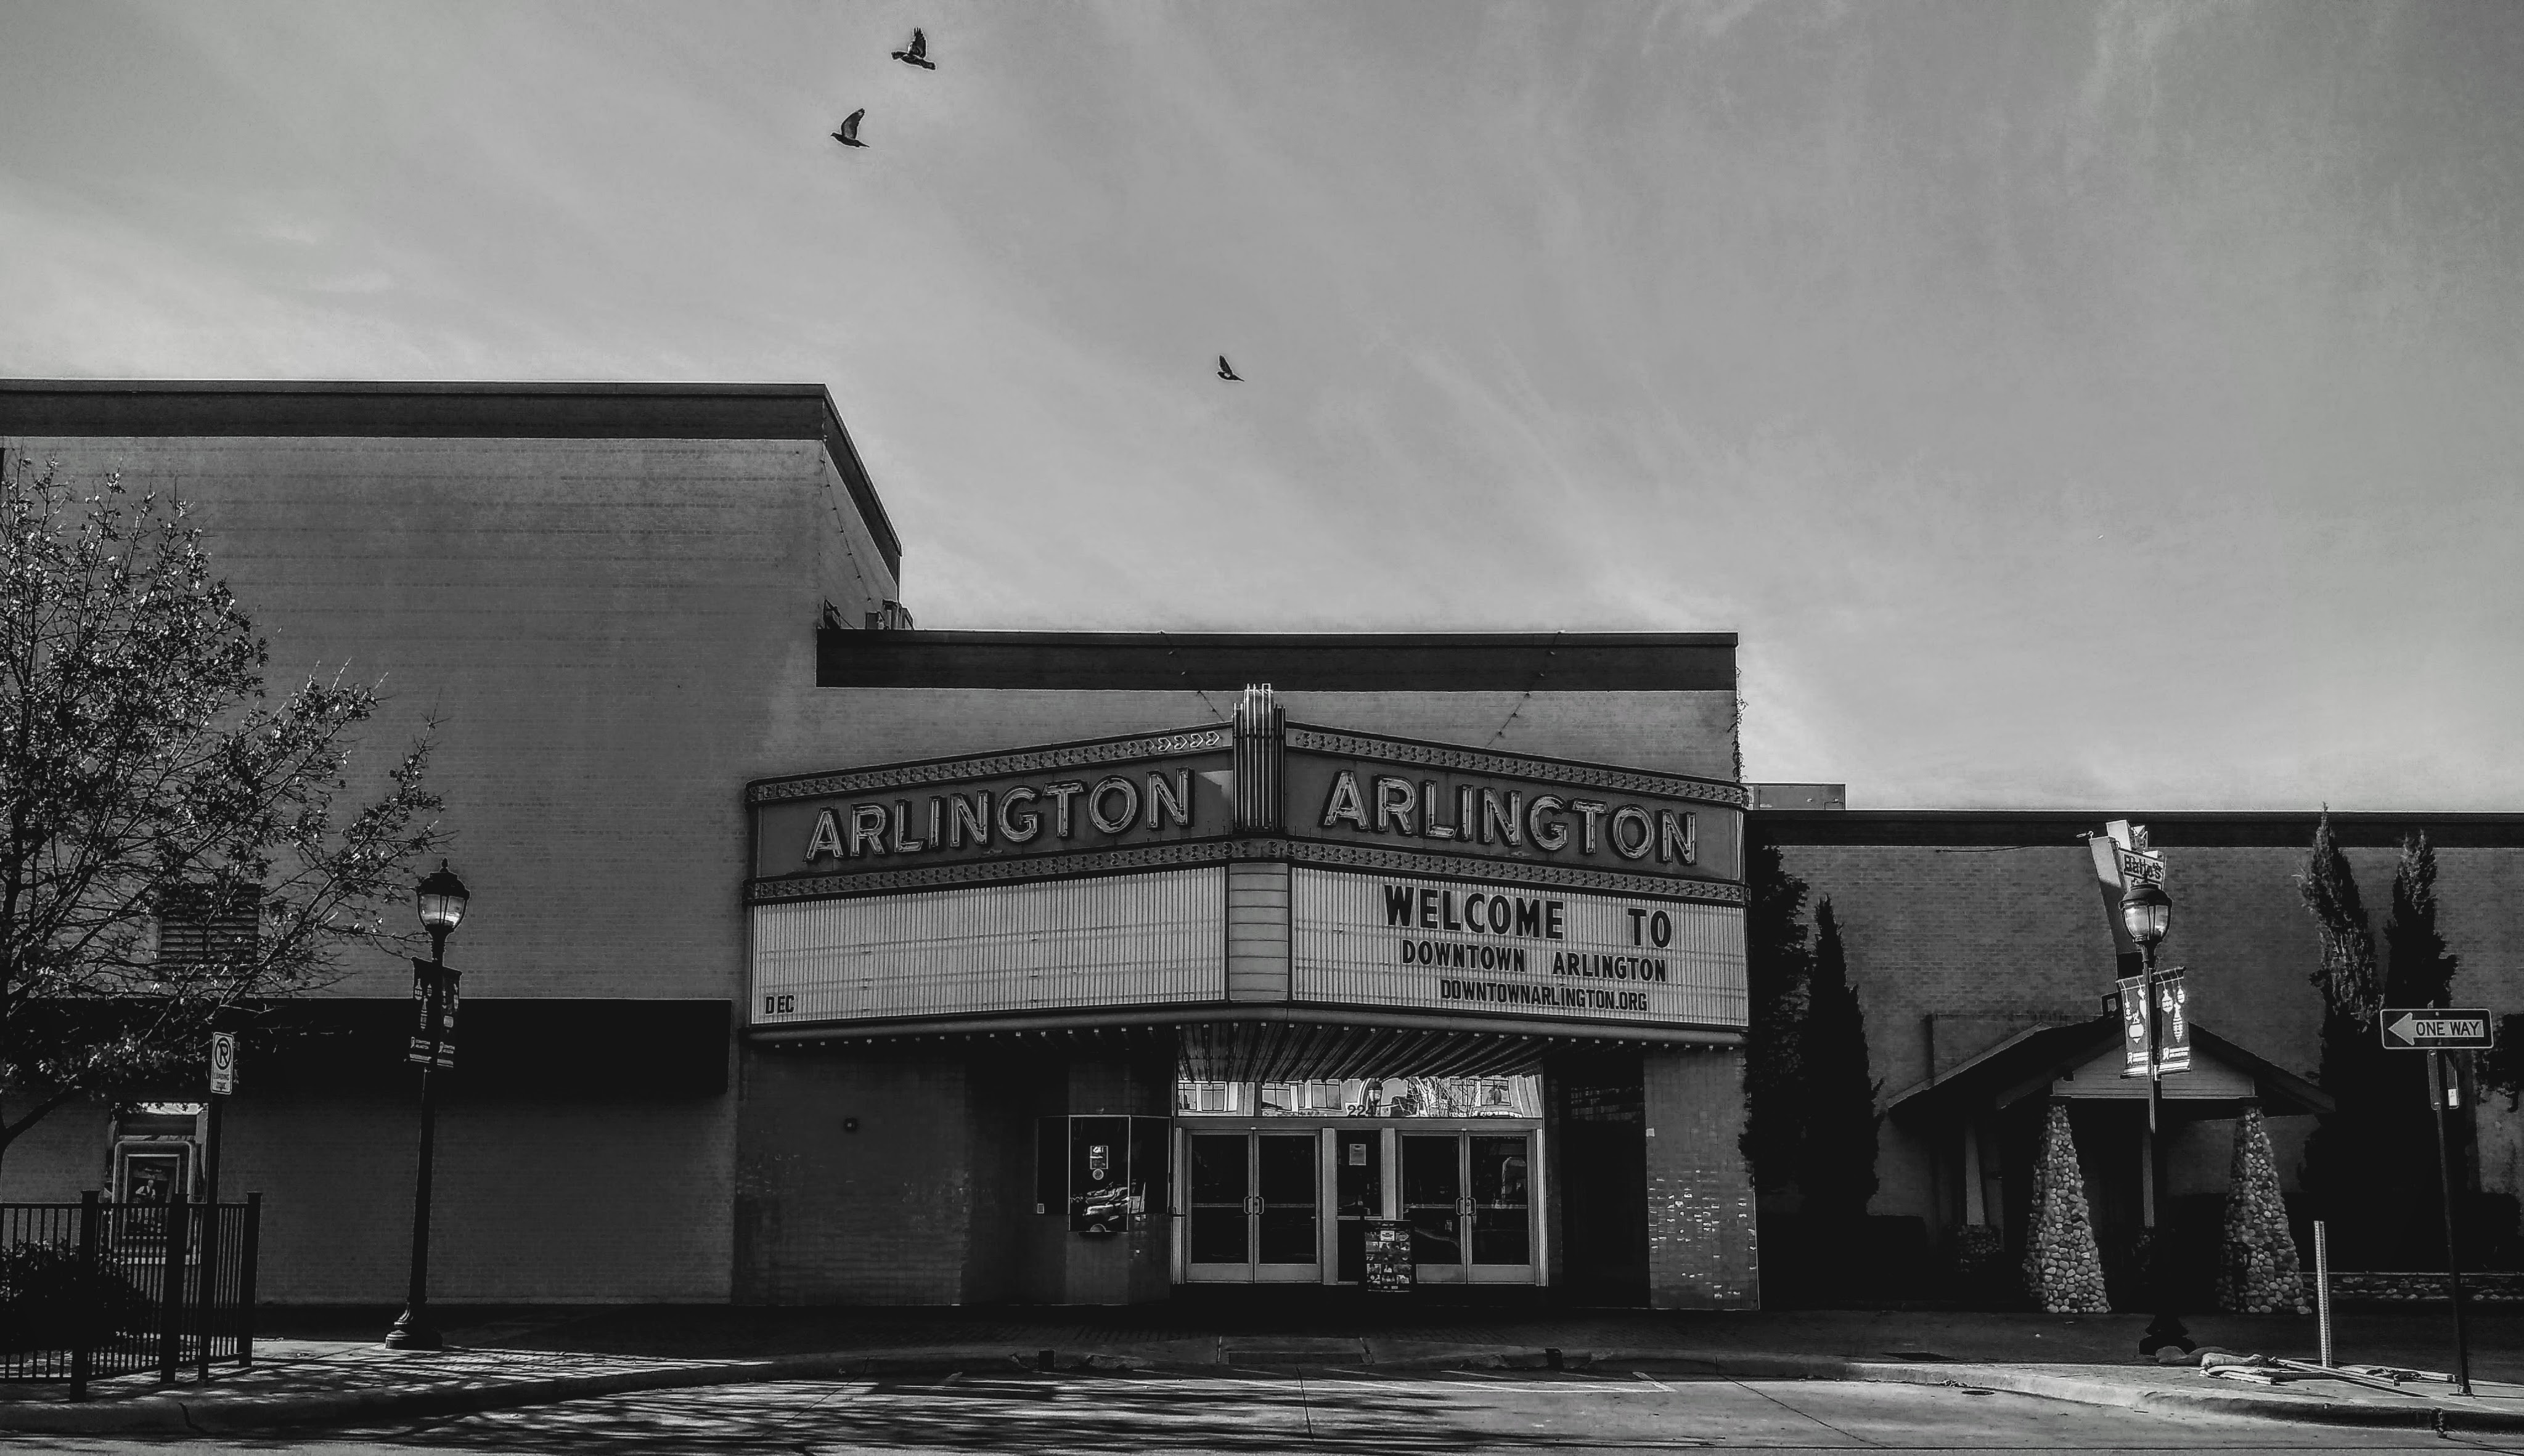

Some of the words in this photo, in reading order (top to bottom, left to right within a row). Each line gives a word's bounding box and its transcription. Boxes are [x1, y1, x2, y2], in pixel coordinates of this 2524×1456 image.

[803, 767, 1195, 863] ARLINGTON
[1322, 770, 1697, 864] ARLINGTON
[1384, 885, 1564, 940] WELCOME
[1628, 908, 1671, 948] TO
[1402, 940, 1525, 972] DOWNTOWN
[1553, 952, 1666, 982] ARLINGTON
[765, 995, 794, 1015] DEC
[1441, 980, 1648, 1011] DOWNTOWNARLINGTON.ORG
[2416, 1022, 2445, 1036] ONE
[2451, 1022, 2479, 1036] WAY
